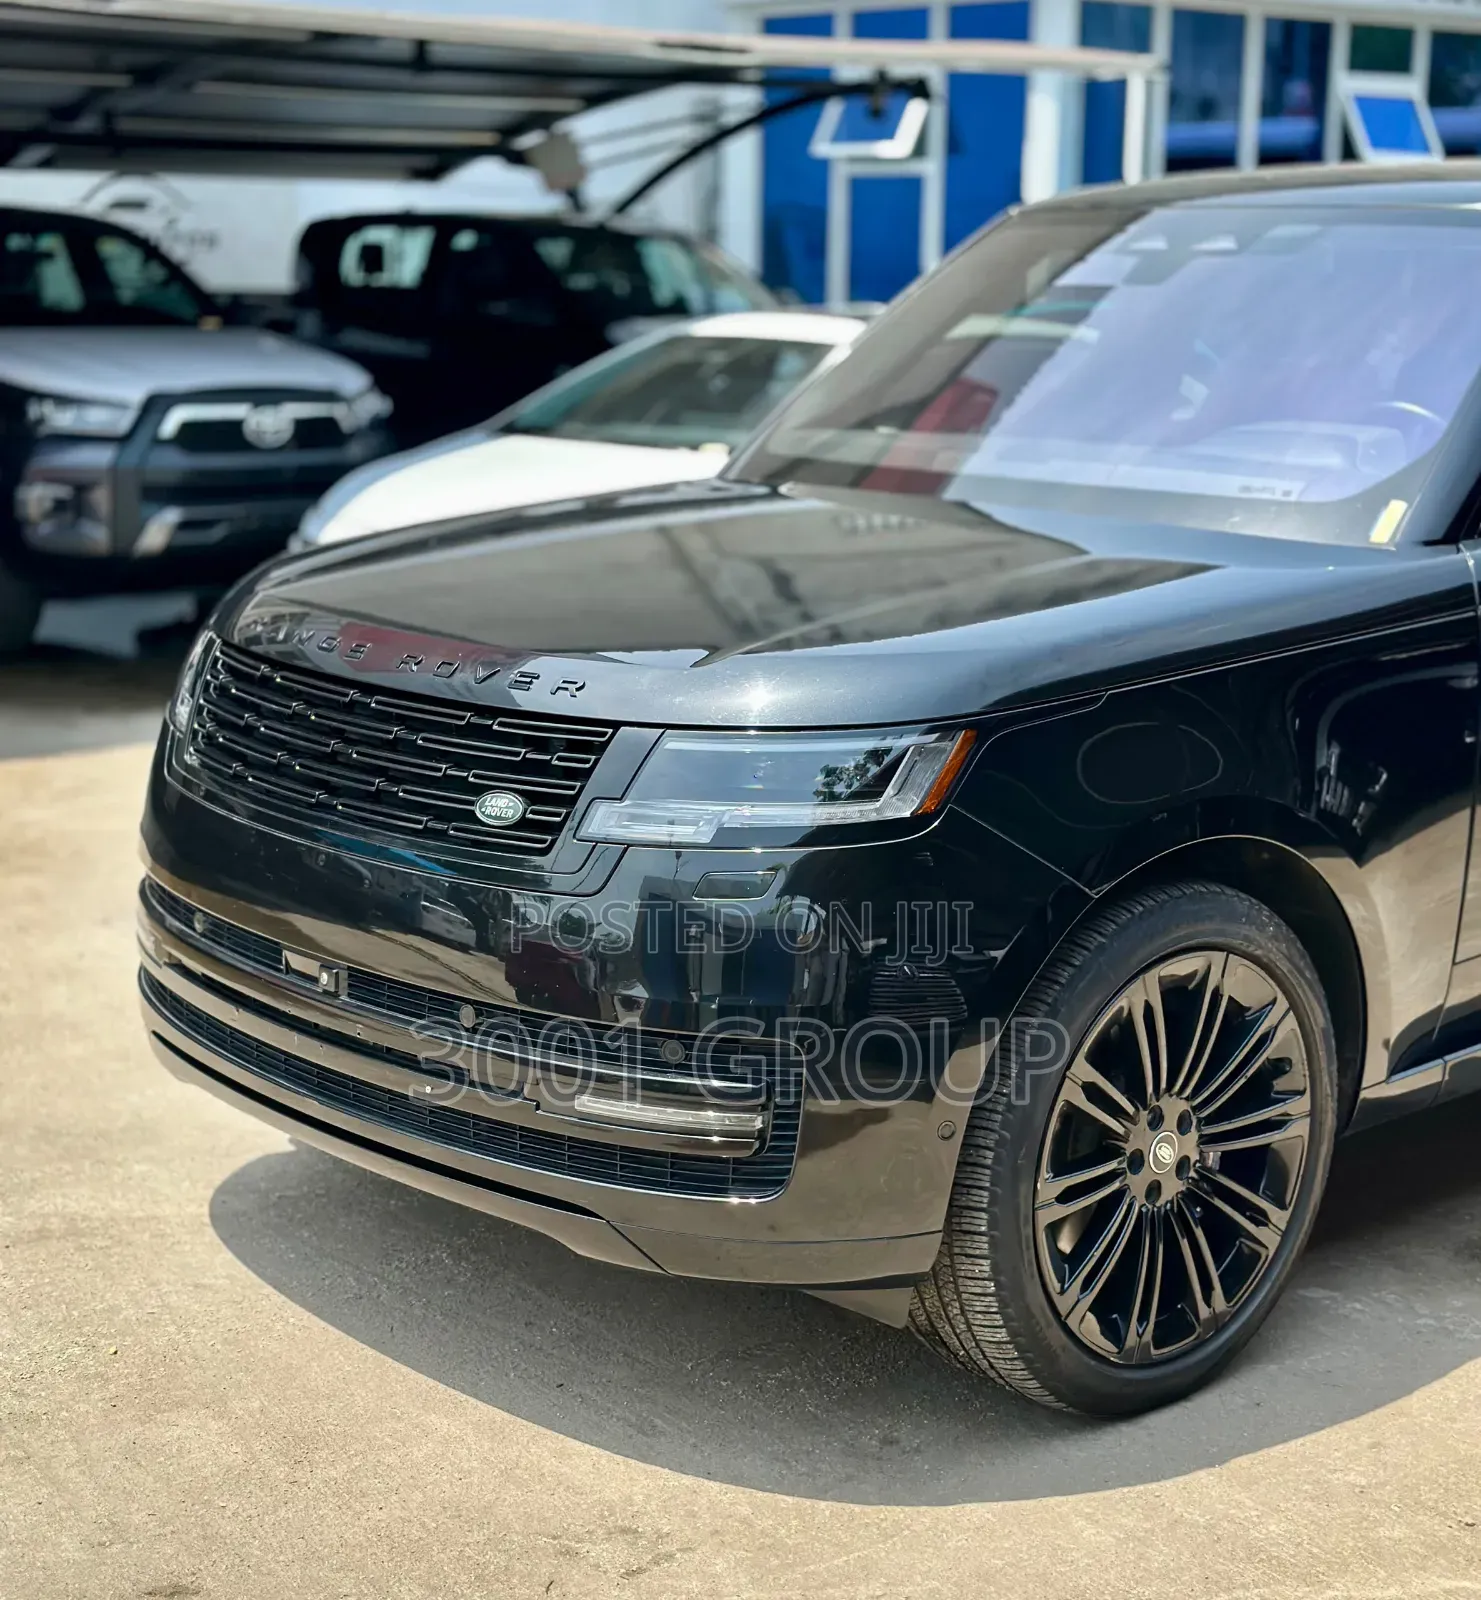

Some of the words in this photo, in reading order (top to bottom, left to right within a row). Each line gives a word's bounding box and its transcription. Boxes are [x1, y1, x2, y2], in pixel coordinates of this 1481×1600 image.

[396, 652, 586, 698] ROVER
[484, 796, 510, 808] LAND
[484, 806, 514, 818] ROVER
